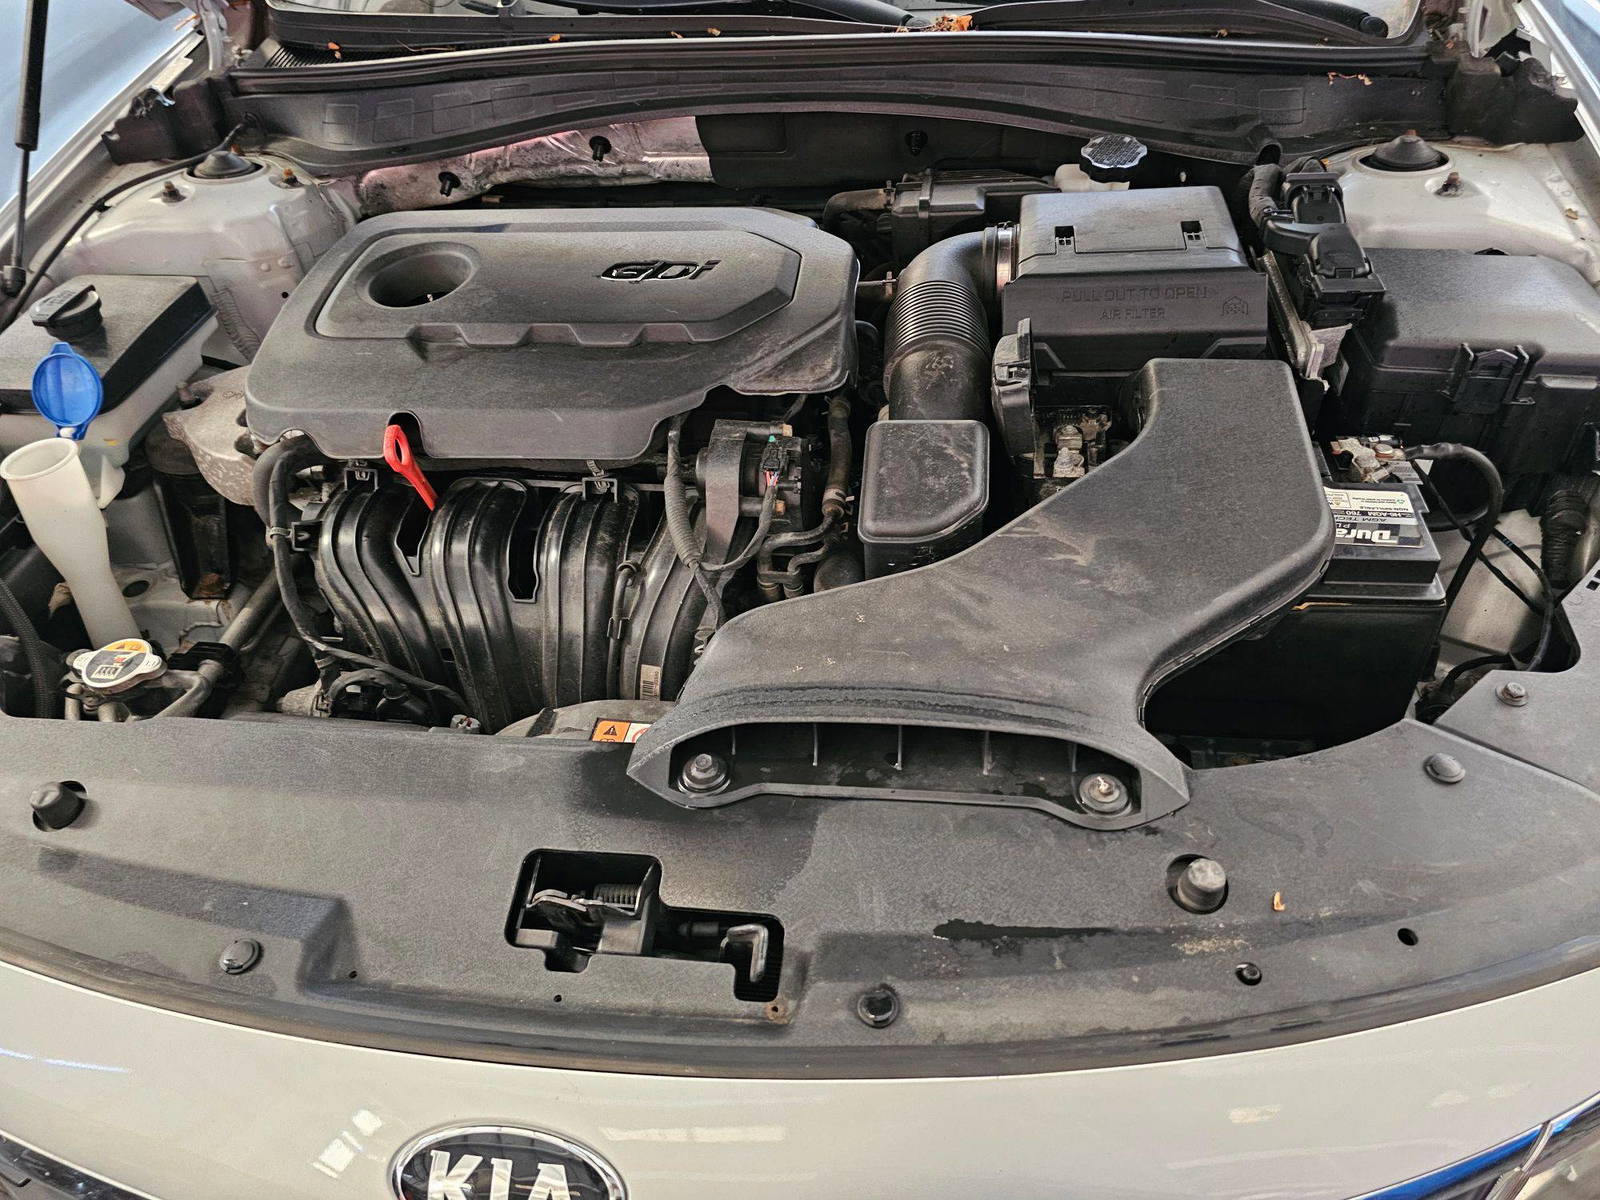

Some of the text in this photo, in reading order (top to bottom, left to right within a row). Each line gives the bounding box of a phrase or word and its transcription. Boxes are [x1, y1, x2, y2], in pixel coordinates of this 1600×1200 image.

[1062, 286, 1208, 302] PULL OUT TO OPEN
[1100, 308, 1166, 320] AIR FILTER
[427, 1149, 573, 1200] KIA
